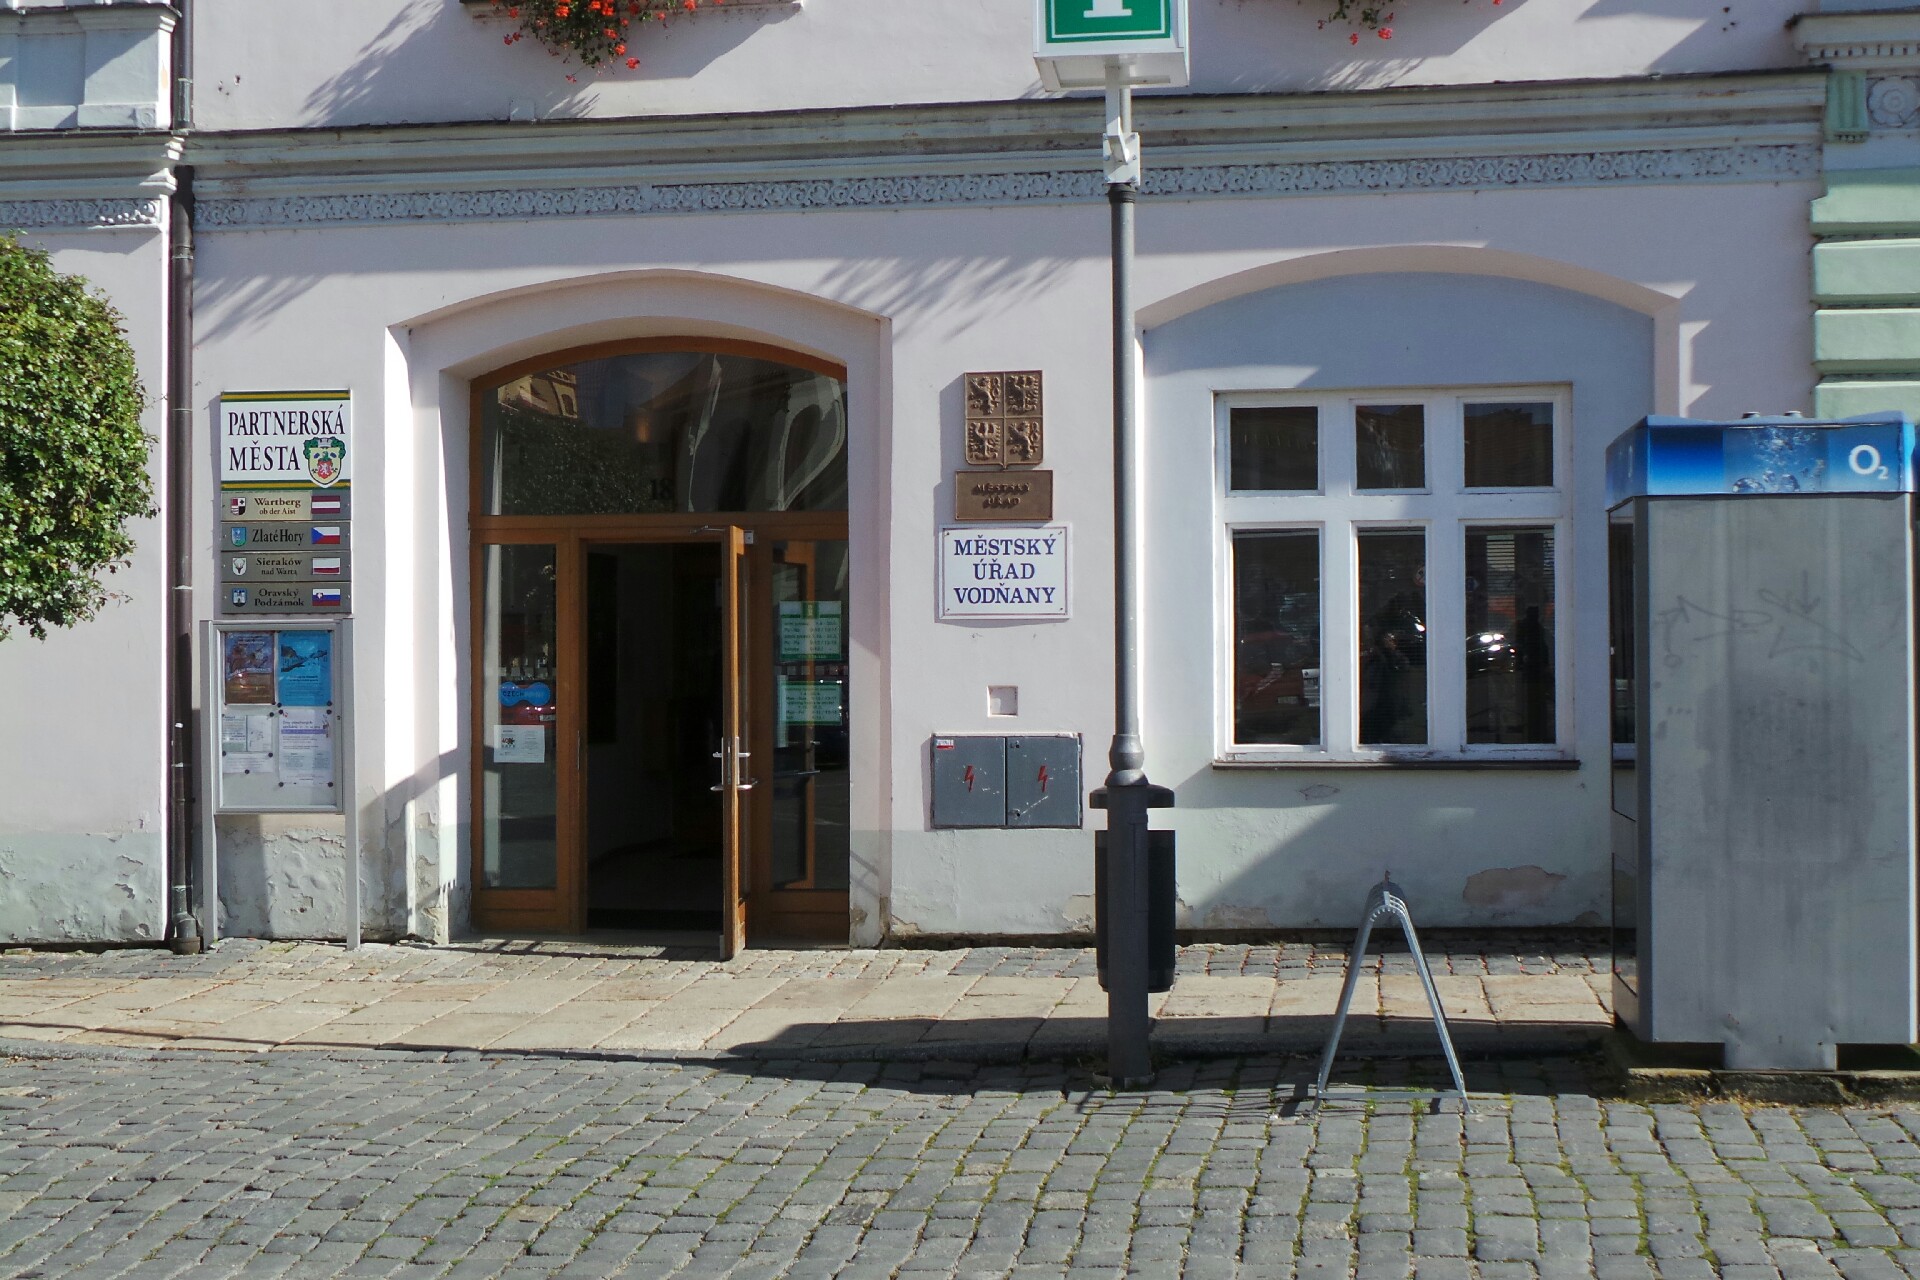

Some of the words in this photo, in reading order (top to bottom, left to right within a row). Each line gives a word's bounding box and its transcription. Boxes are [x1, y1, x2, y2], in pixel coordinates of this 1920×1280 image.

[228, 404, 345, 436] PARTNERSKÁ
[229, 440, 300, 471] MĚSTA
[1848, 444, 1889, 480] O2
[254, 497, 301, 508] Wartberg
[252, 528, 279, 543] Zlaté
[280, 529, 304, 546] Hory
[954, 533, 1056, 556] MĚSTSKÝ
[256, 557, 302, 566] Sieraków
[261, 567, 274, 575] nad
[973, 558, 1035, 580] ÚŘAD
[254, 598, 304, 607] Podzámok
[258, 588, 299, 598] Oravský
[953, 583, 1056, 604] VODŇANY
